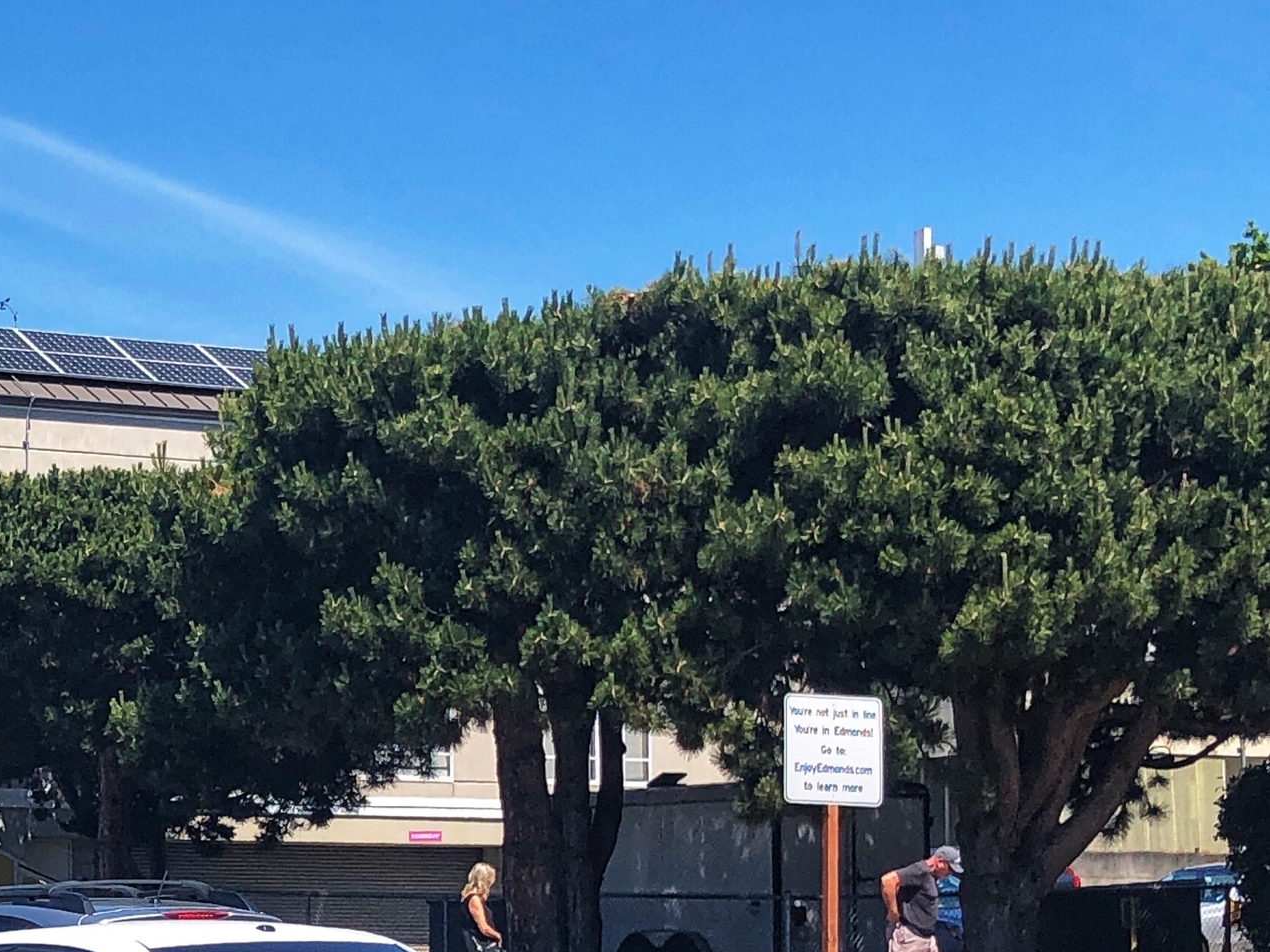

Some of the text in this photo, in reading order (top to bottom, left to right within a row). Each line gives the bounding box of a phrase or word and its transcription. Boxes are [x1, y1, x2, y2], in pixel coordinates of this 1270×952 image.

[789, 706, 812, 716] You're
[816, 708, 829, 717] not
[833, 709, 848, 720] just
[852, 710, 859, 719] in
[794, 724, 874, 738] You're in Edmonds!
[821, 745, 832, 755] Go
[794, 762, 873, 776] EnjoyEdmonds.com
[804, 781, 863, 793] to learn more
